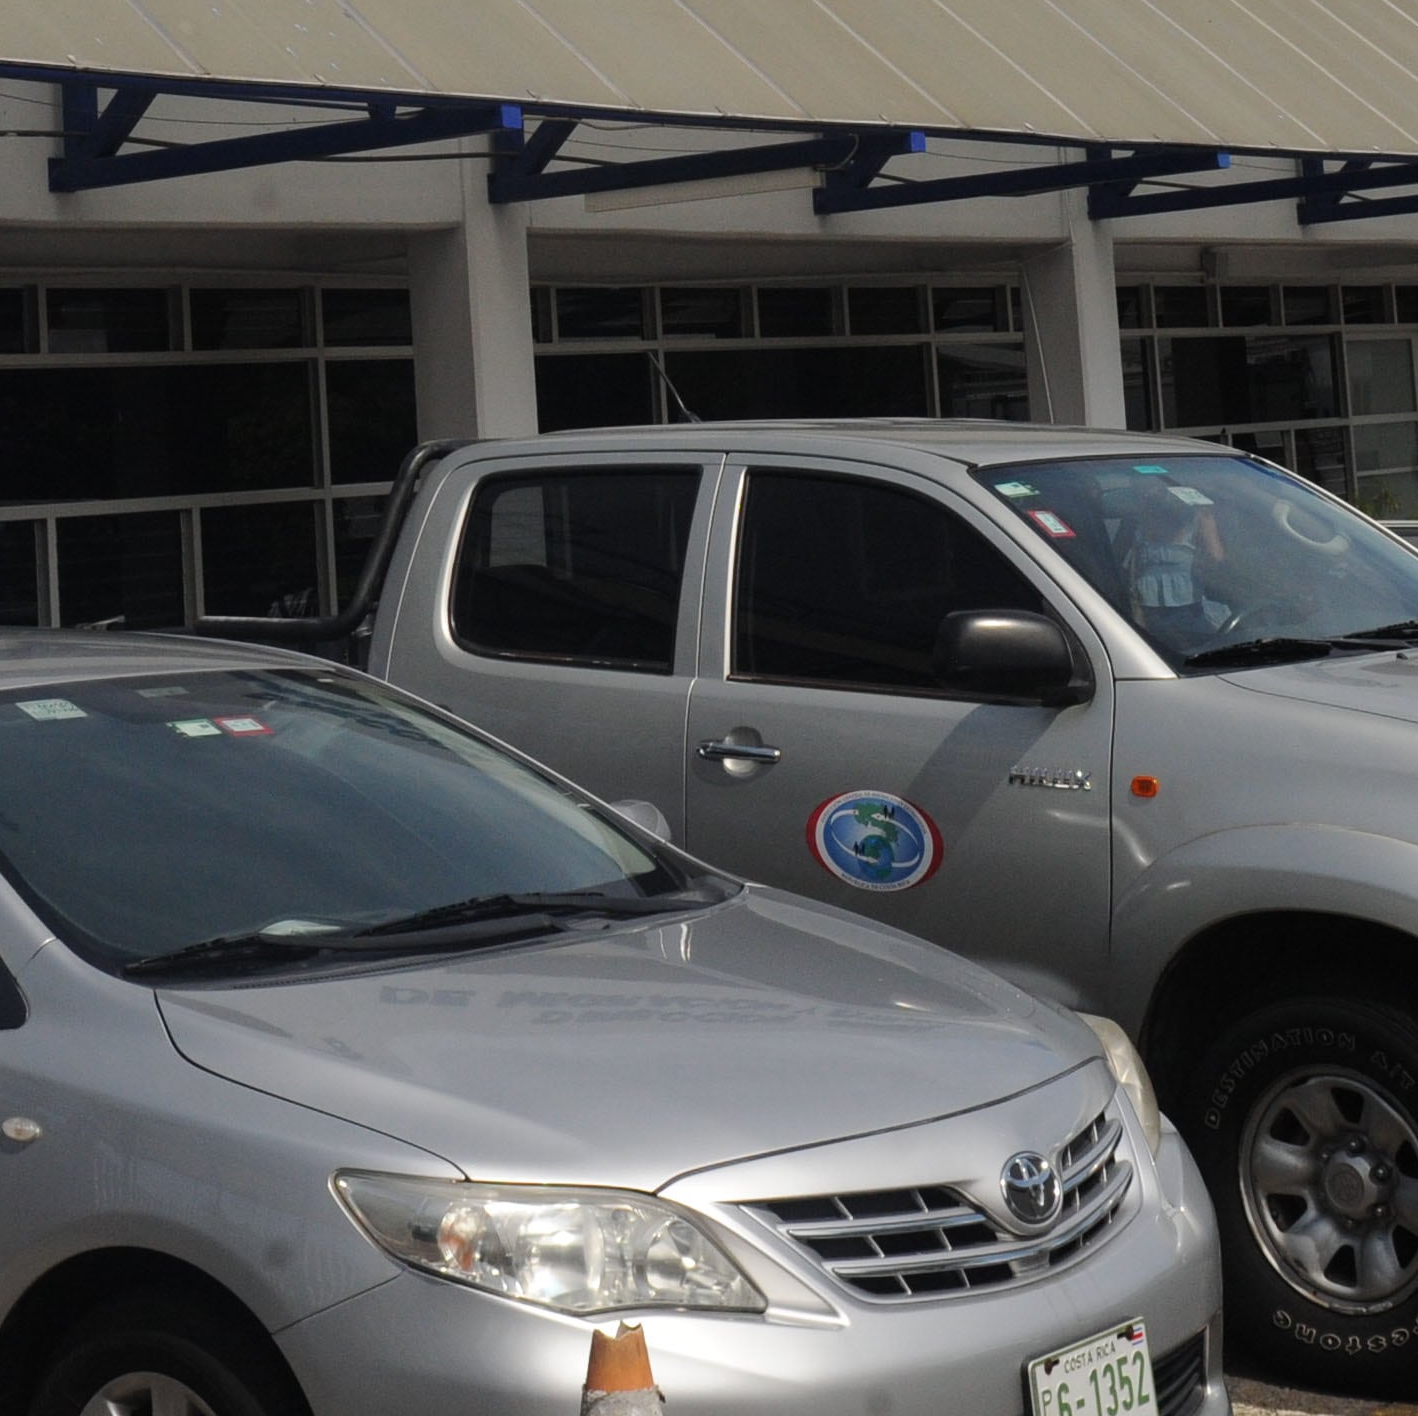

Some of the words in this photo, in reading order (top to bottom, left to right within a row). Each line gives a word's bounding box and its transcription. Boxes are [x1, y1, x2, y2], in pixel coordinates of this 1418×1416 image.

[1205, 1025, 1357, 1130] DESTINATION
[1057, 1350, 1150, 1416] 6-1352
[1063, 1351, 1093, 1374] COSTA
[1096, 1341, 1116, 1360] RICA
